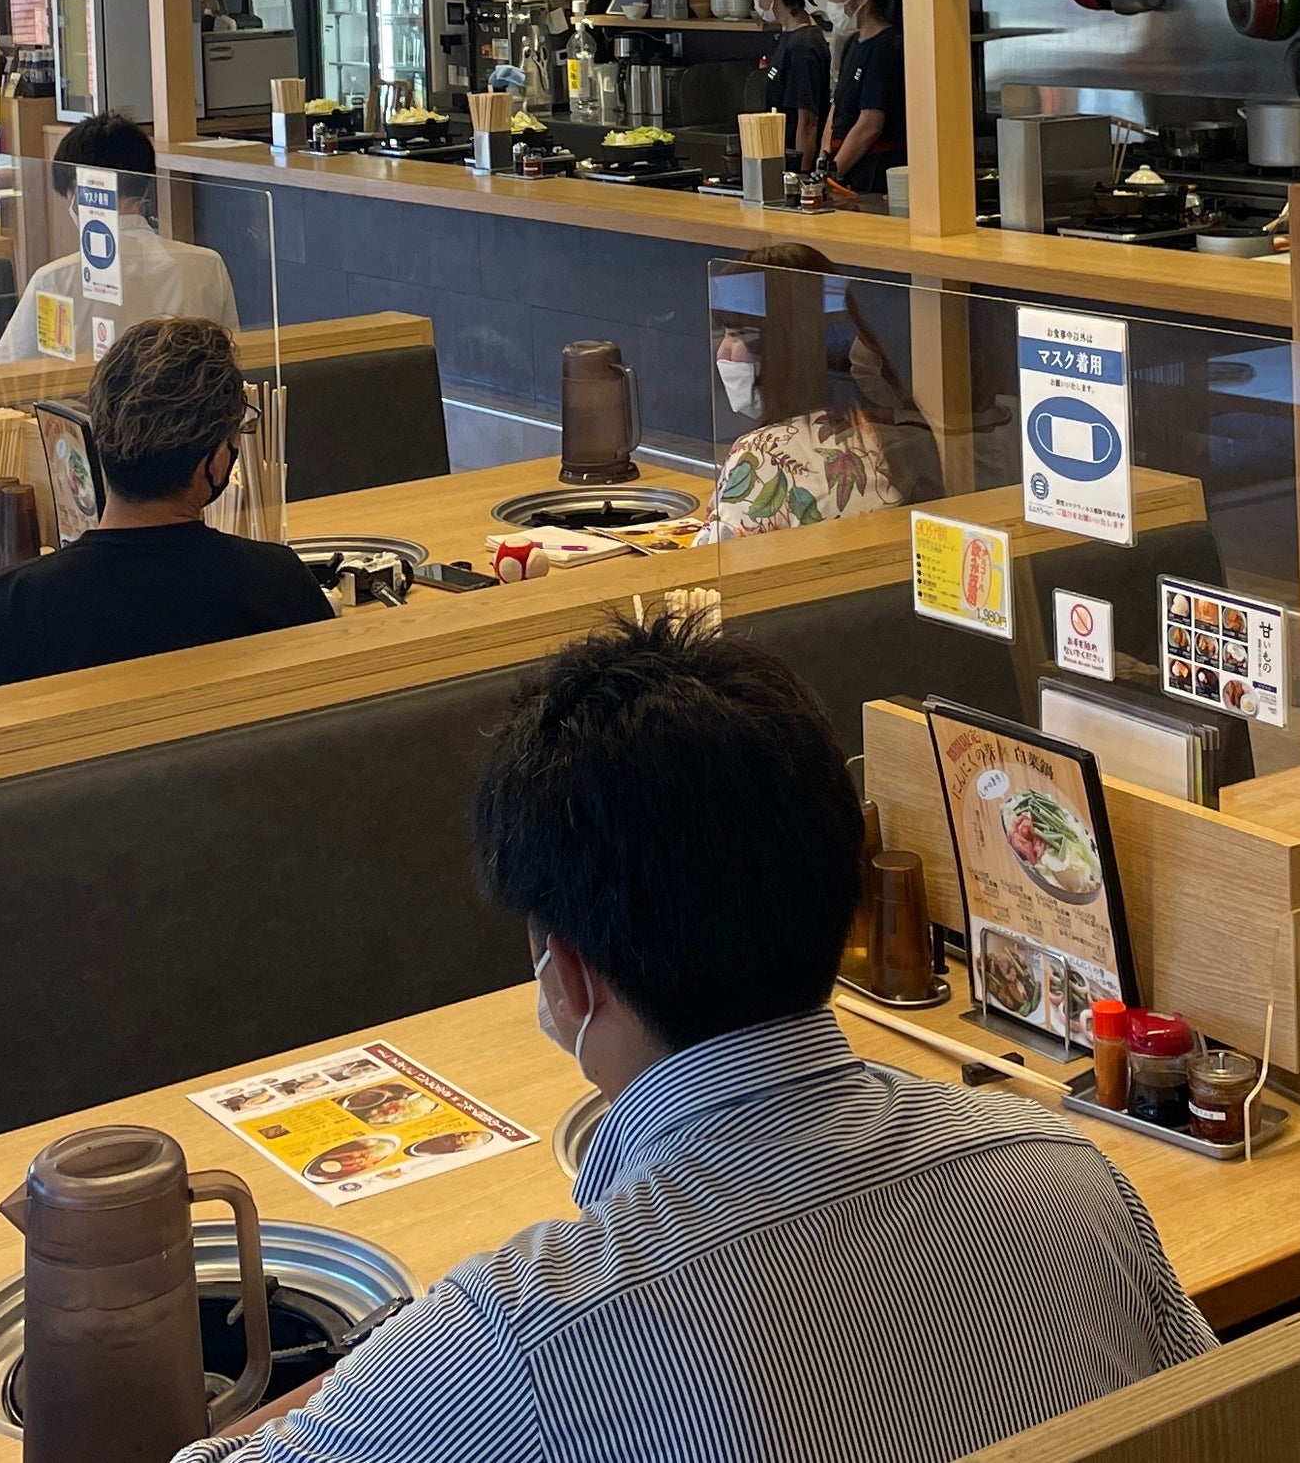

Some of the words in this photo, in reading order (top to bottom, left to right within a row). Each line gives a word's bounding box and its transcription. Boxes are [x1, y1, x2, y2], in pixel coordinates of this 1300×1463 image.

[1037, 349, 1103, 376] マスク着用
[1259, 621, 1274, 674] 甘いもの
